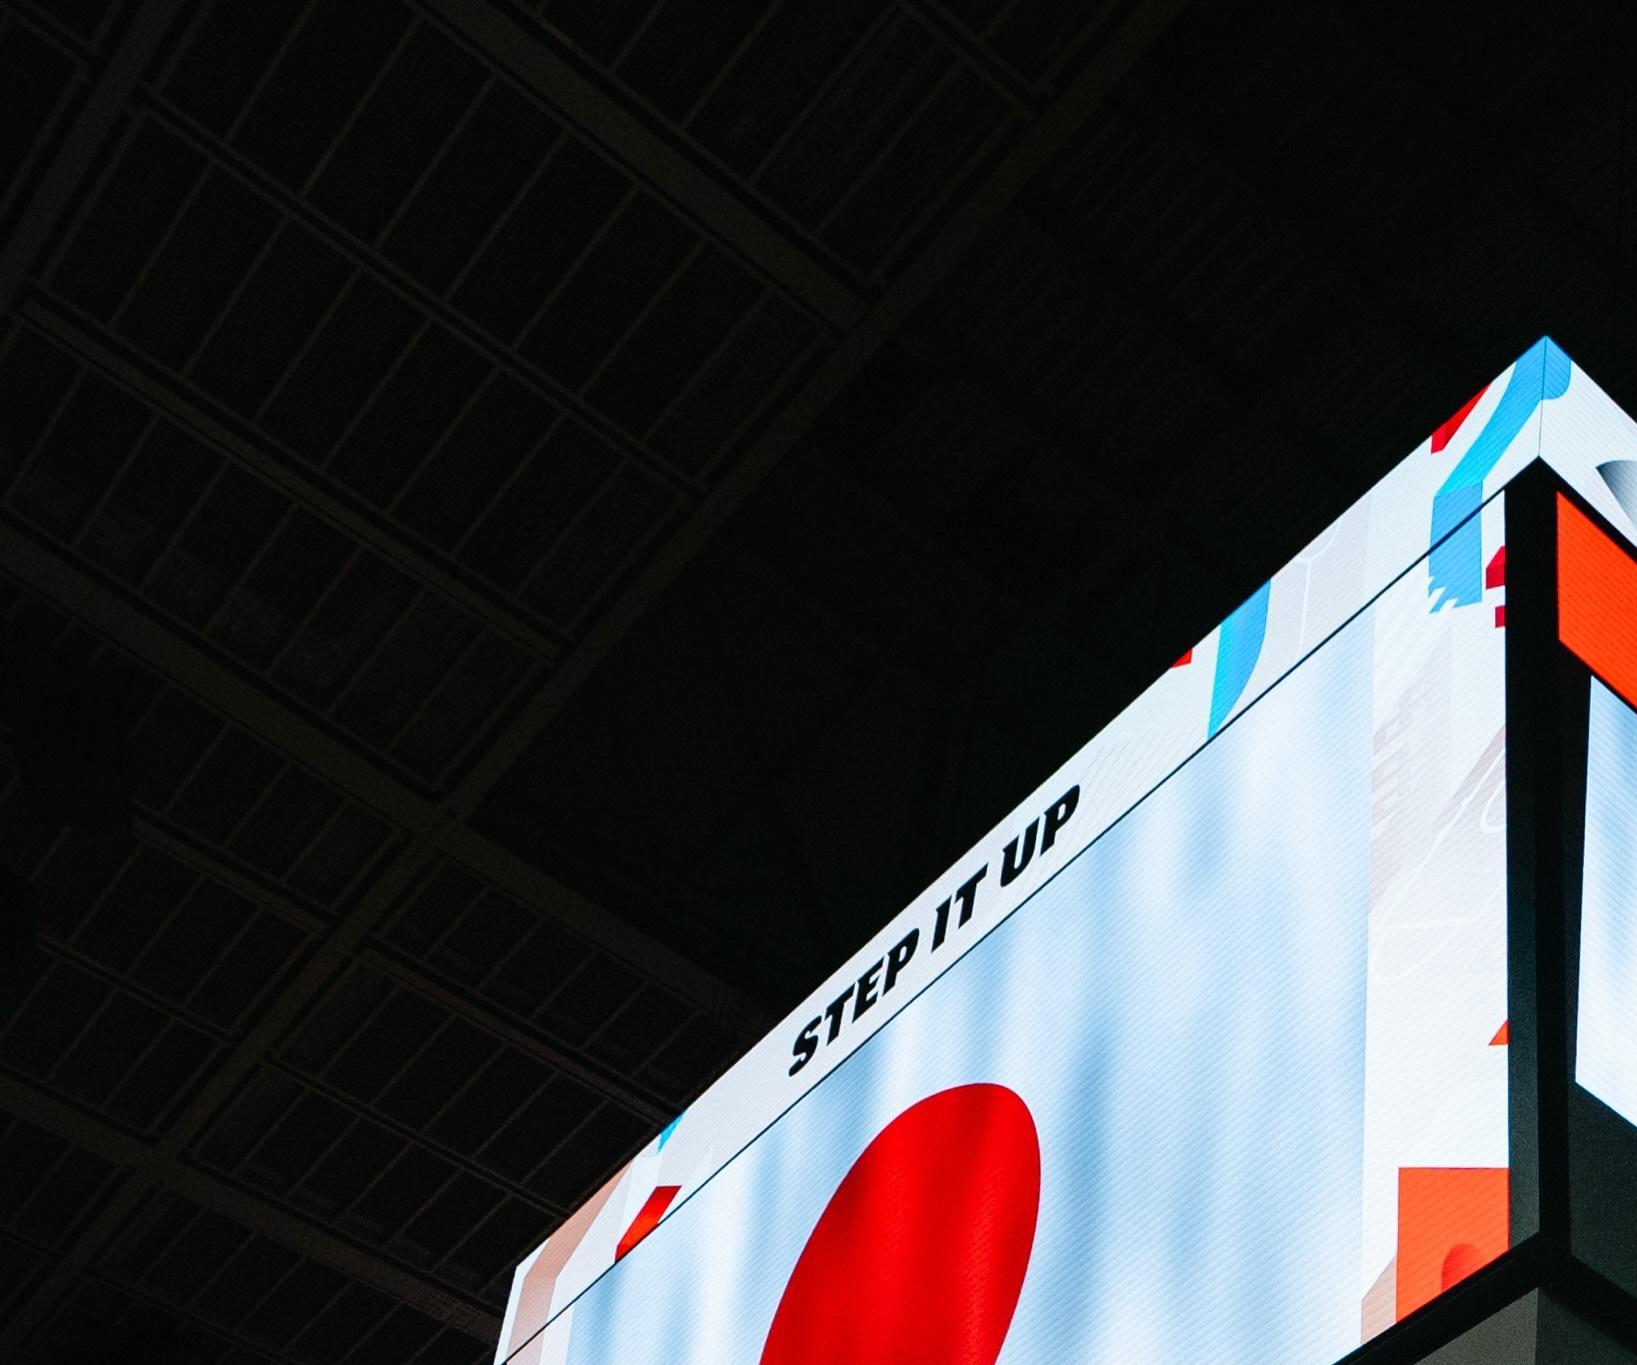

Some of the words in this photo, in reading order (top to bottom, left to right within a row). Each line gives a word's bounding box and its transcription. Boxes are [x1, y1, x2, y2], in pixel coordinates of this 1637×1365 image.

[788, 927, 920, 1077] STEP
[931, 862, 989, 954] IT
[1000, 784, 1081, 888] UP
